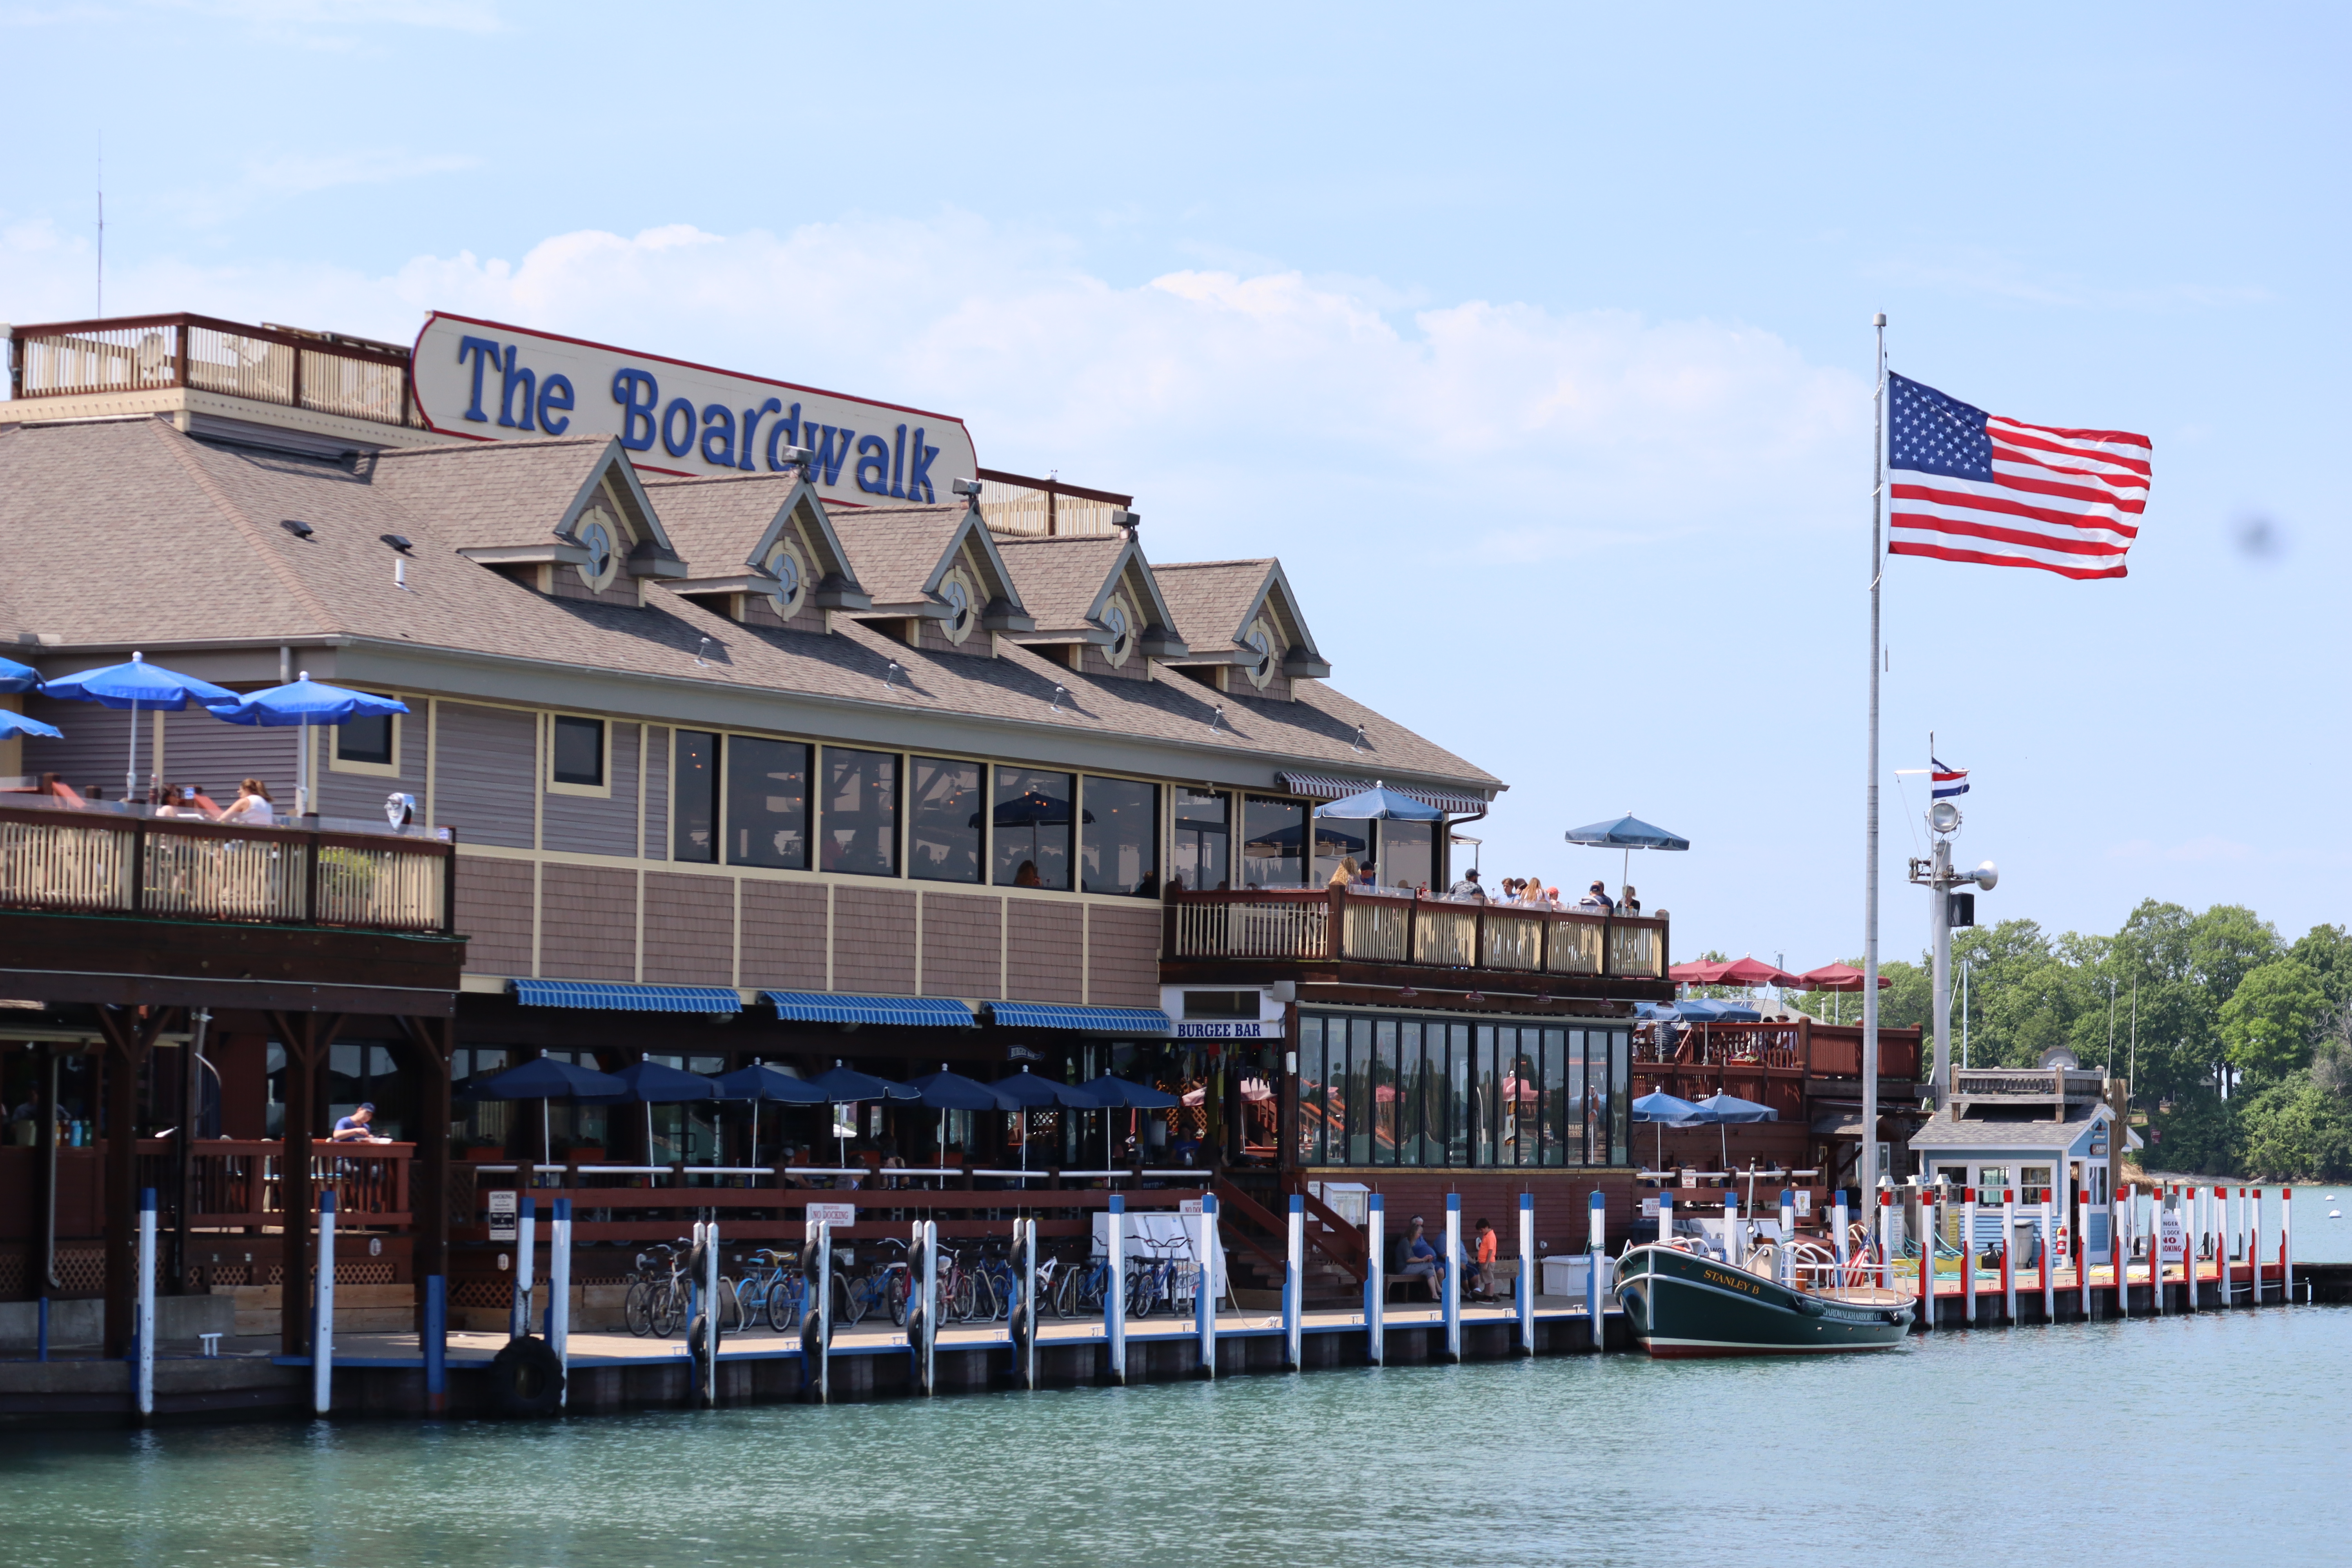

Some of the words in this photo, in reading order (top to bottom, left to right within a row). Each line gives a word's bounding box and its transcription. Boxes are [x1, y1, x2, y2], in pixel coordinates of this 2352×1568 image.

[459, 336, 575, 435] The
[613, 368, 940, 504] Boardwalk
[1178, 1024, 1231, 1037] BURGEE
[1235, 1024, 1261, 1037] BAR
[812, 1210, 822, 1219] NO
[823, 1210, 848, 1220] DOCKING
[1704, 1269, 1751, 1291] STANLEY
[1752, 1285, 1760, 1294] B
